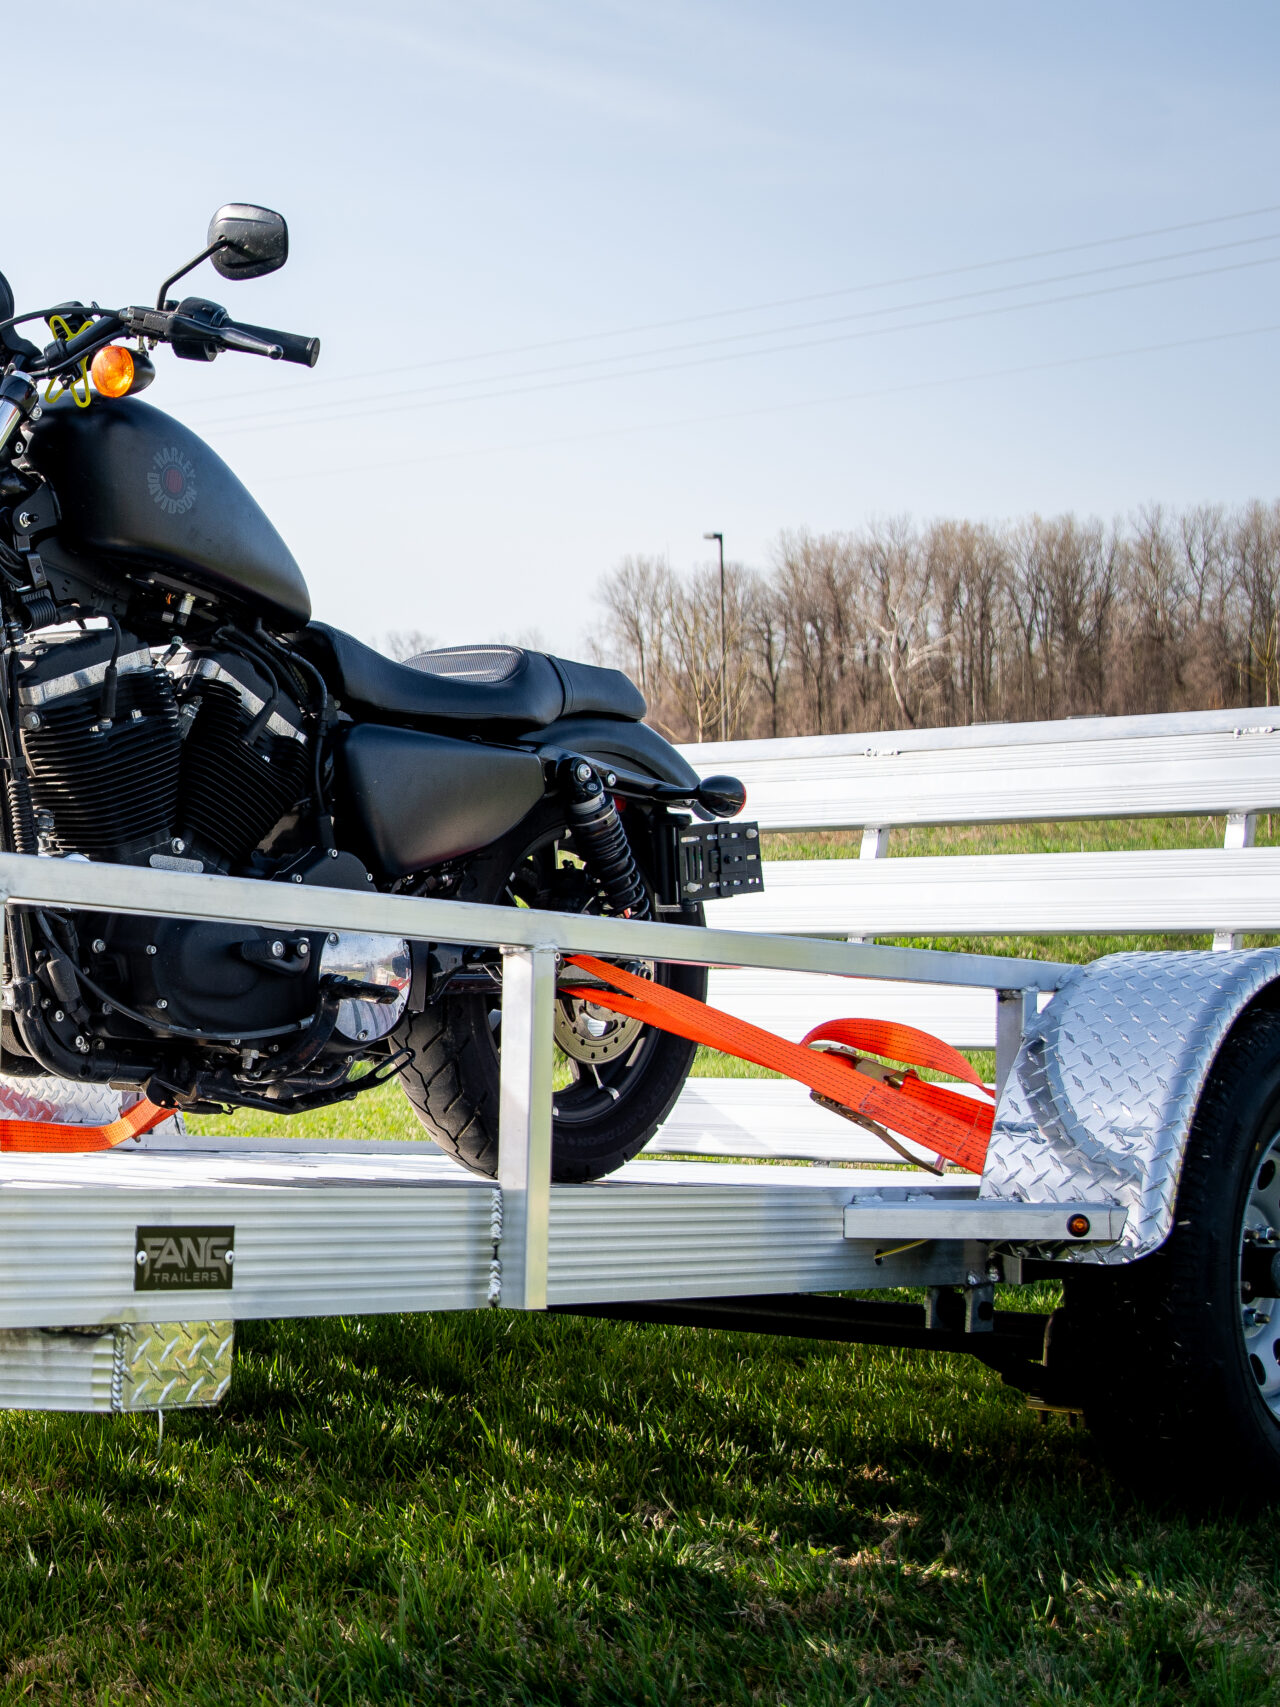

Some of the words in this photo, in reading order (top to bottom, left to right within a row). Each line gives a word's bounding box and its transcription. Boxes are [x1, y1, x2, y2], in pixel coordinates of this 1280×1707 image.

[153, 447, 196, 478] HARLEY
[147, 472, 197, 514] DAVIDSON
[142, 1237, 231, 1282] FANG
[153, 1272, 218, 1283] TRAILERS
